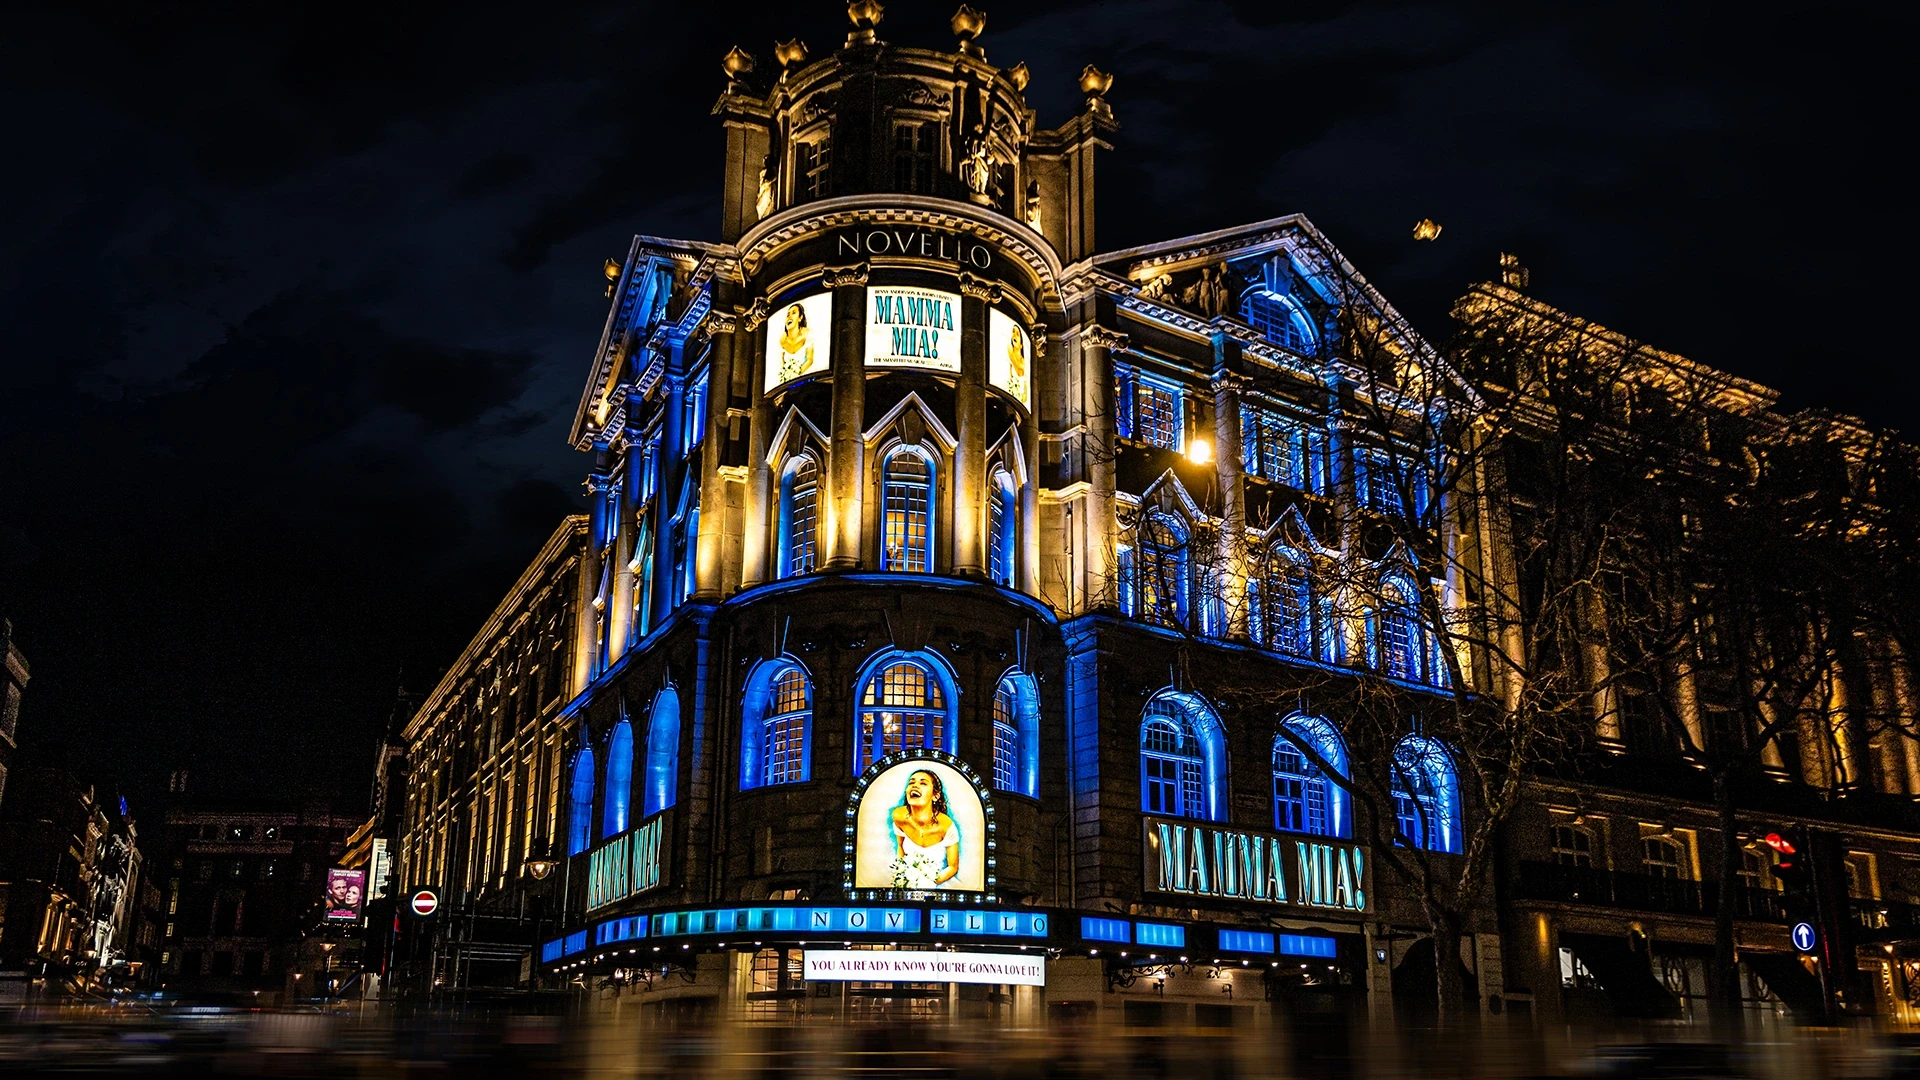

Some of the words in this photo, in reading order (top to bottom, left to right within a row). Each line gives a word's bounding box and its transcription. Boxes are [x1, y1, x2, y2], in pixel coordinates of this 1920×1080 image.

[838, 230, 991, 269] NOVELLO
[874, 295, 954, 331] MAMMA
[891, 327, 938, 359] MIA!
[586, 834, 629, 913] MAMMA
[631, 814, 663, 896] MIA!
[1157, 822, 1288, 903] MAMMA
[1295, 840, 1365, 912] MIA!
[813, 911, 1046, 933] NOVELLO
[811, 960, 836, 971] YOU
[838, 960, 891, 971] ALREADY
[894, 961, 928, 971] KNOW
[930, 961, 967, 973] YOU'RE
[969, 962, 1003, 975] GONNA
[1004, 964, 1026, 976] LOVE
[1027, 966, 1041, 977] IT!
